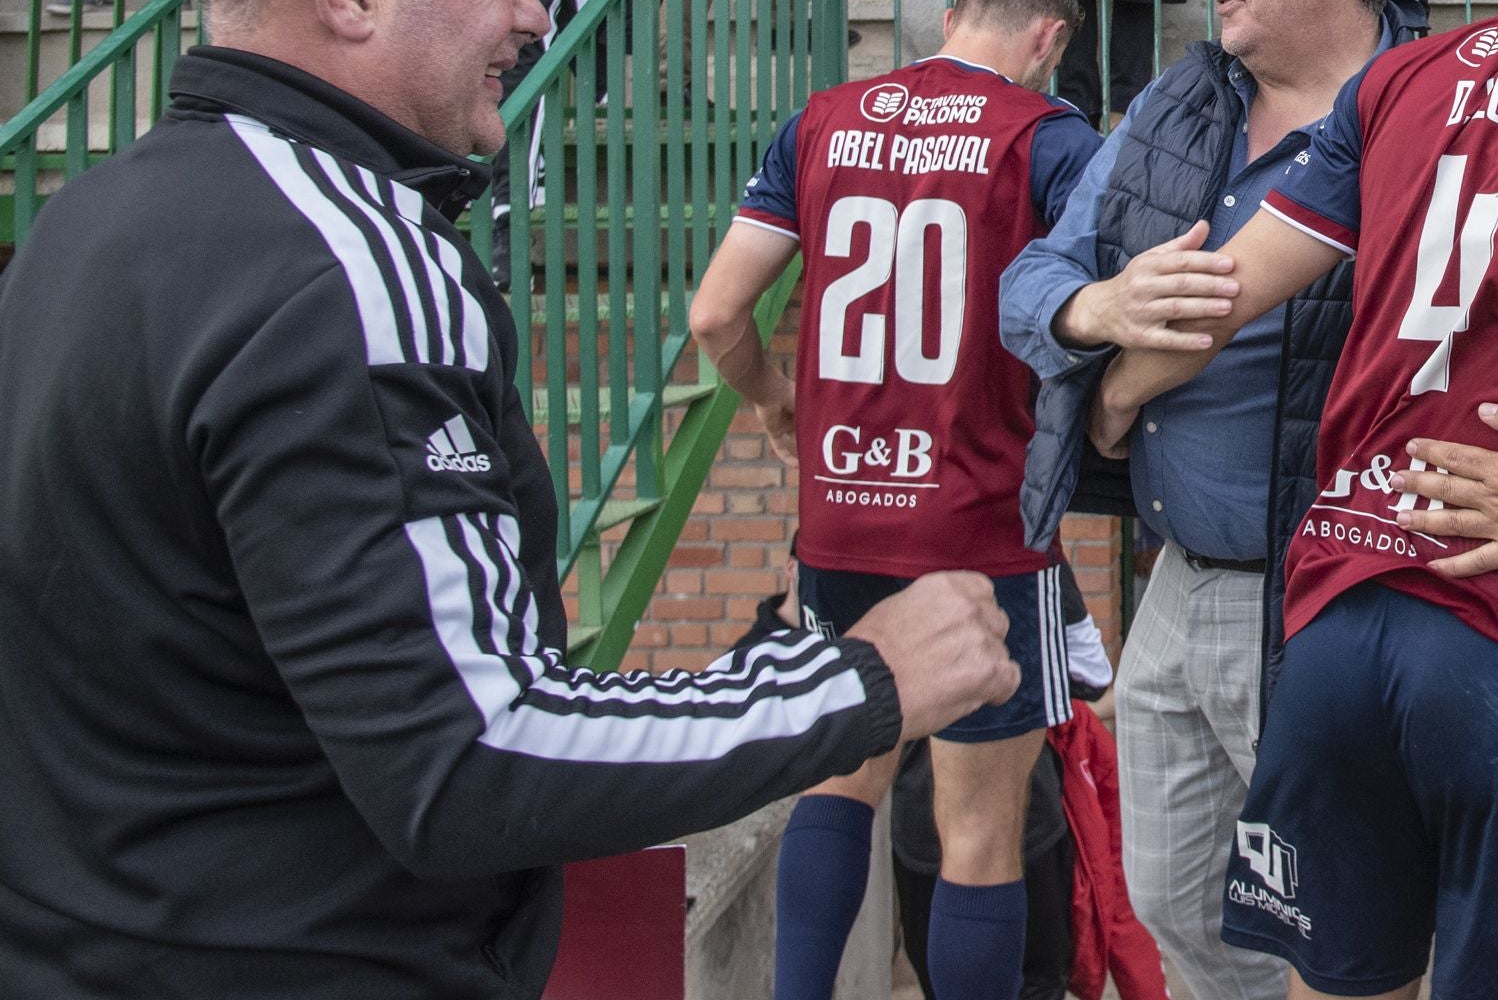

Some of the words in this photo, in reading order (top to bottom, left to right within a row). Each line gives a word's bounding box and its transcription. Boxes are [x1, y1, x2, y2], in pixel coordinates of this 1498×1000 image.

[903, 106, 982, 126] PALOMO
[910, 94, 988, 110] OCTAVIANO
[827, 129, 885, 171] ABEL
[889, 133, 991, 175] PASCUAL
[818, 195, 968, 385] 20
[822, 424, 933, 478] G&B
[825, 489, 918, 508] ABOGADOS
